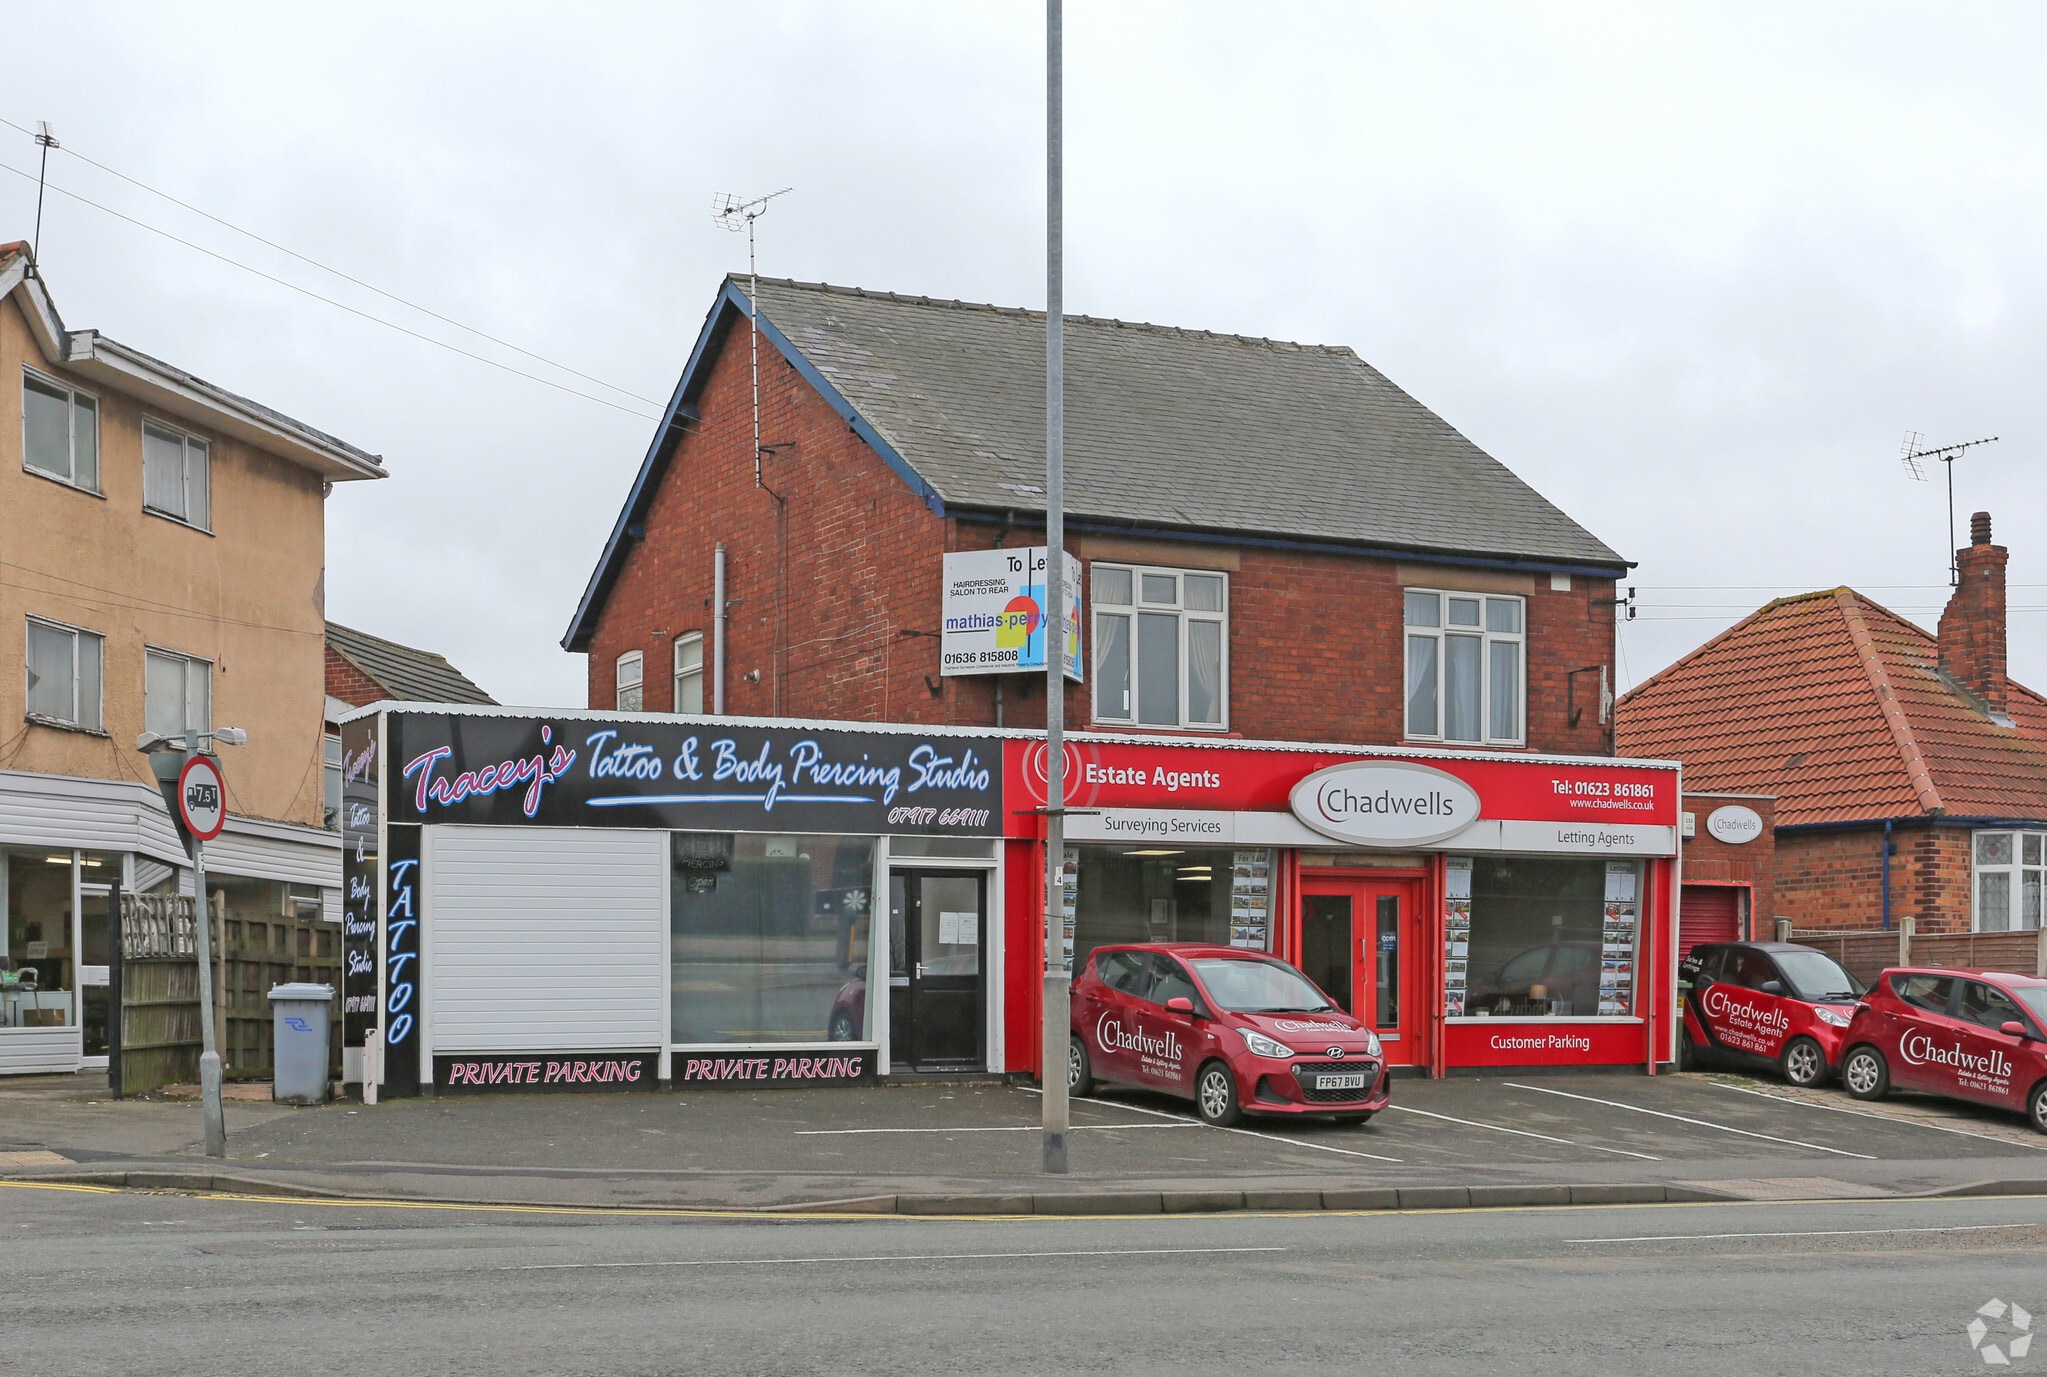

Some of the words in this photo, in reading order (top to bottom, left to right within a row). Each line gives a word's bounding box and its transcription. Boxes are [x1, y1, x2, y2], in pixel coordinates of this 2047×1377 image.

[1007, 557, 1022, 572] To
[1028, 556, 1048, 571] Le
[950, 588, 975, 597] SALON
[977, 587, 987, 595] TO
[989, 586, 1009, 594] REAR
[953, 578, 1006, 589] HAIRDRESSING
[944, 652, 977, 665] 01636
[979, 650, 1018, 663] 815808
[403, 725, 577, 817] Tracey's
[586, 730, 662, 780] Tattoo
[673, 736, 703, 781] &
[711, 738, 786, 812] Body
[790, 739, 901, 806] Piercing
[907, 744, 989, 793] Studio
[1085, 763, 1147, 785] Estate
[1152, 766, 1221, 792] Agents
[1552, 780, 1572, 795] Tel:
[1575, 782, 1610, 796] 01623
[1614, 784, 1654, 798] 861861
[1325, 787, 1454, 817] Chadwells
[1570, 799, 1655, 811] www.chadwells.co.uk
[350, 803, 370, 828] Tattoo
[887, 806, 937, 826] 07917
[938, 807, 990, 827] 669111
[1105, 816, 1168, 835] Surveying
[1171, 818, 1221, 834] Services
[1716, 819, 1756, 831] Chadwells
[356, 836, 364, 862] &
[1558, 830, 1595, 846] Letting
[1598, 831, 1635, 847] Agents
[351, 874, 371, 911] Body
[345, 912, 376, 942] Piercing
[349, 950, 373, 976] Studio
[388, 859, 420, 1044] TATTOO
[1711, 991, 1789, 1030] Chadwells
[1729, 1014, 1753, 1029] Estate
[1754, 1021, 1783, 1038] Agents
[1104, 1020, 1182, 1061] Chadwells
[1490, 1035, 1546, 1050] Customer
[1548, 1034, 1590, 1051] Parking
[1720, 1033, 1741, 1045] 01623
[1909, 1035, 2012, 1077] Chadwells
[449, 1062, 541, 1084] PRIVATE
[543, 1061, 642, 1083] PARKING
[684, 1058, 768, 1080] PRIVATE
[772, 1057, 862, 1079] PARKING
[1320, 1077, 1343, 1088] FP67
[1344, 1076, 1361, 1087] BVU
[1958, 1078, 1969, 1087] Tel:
